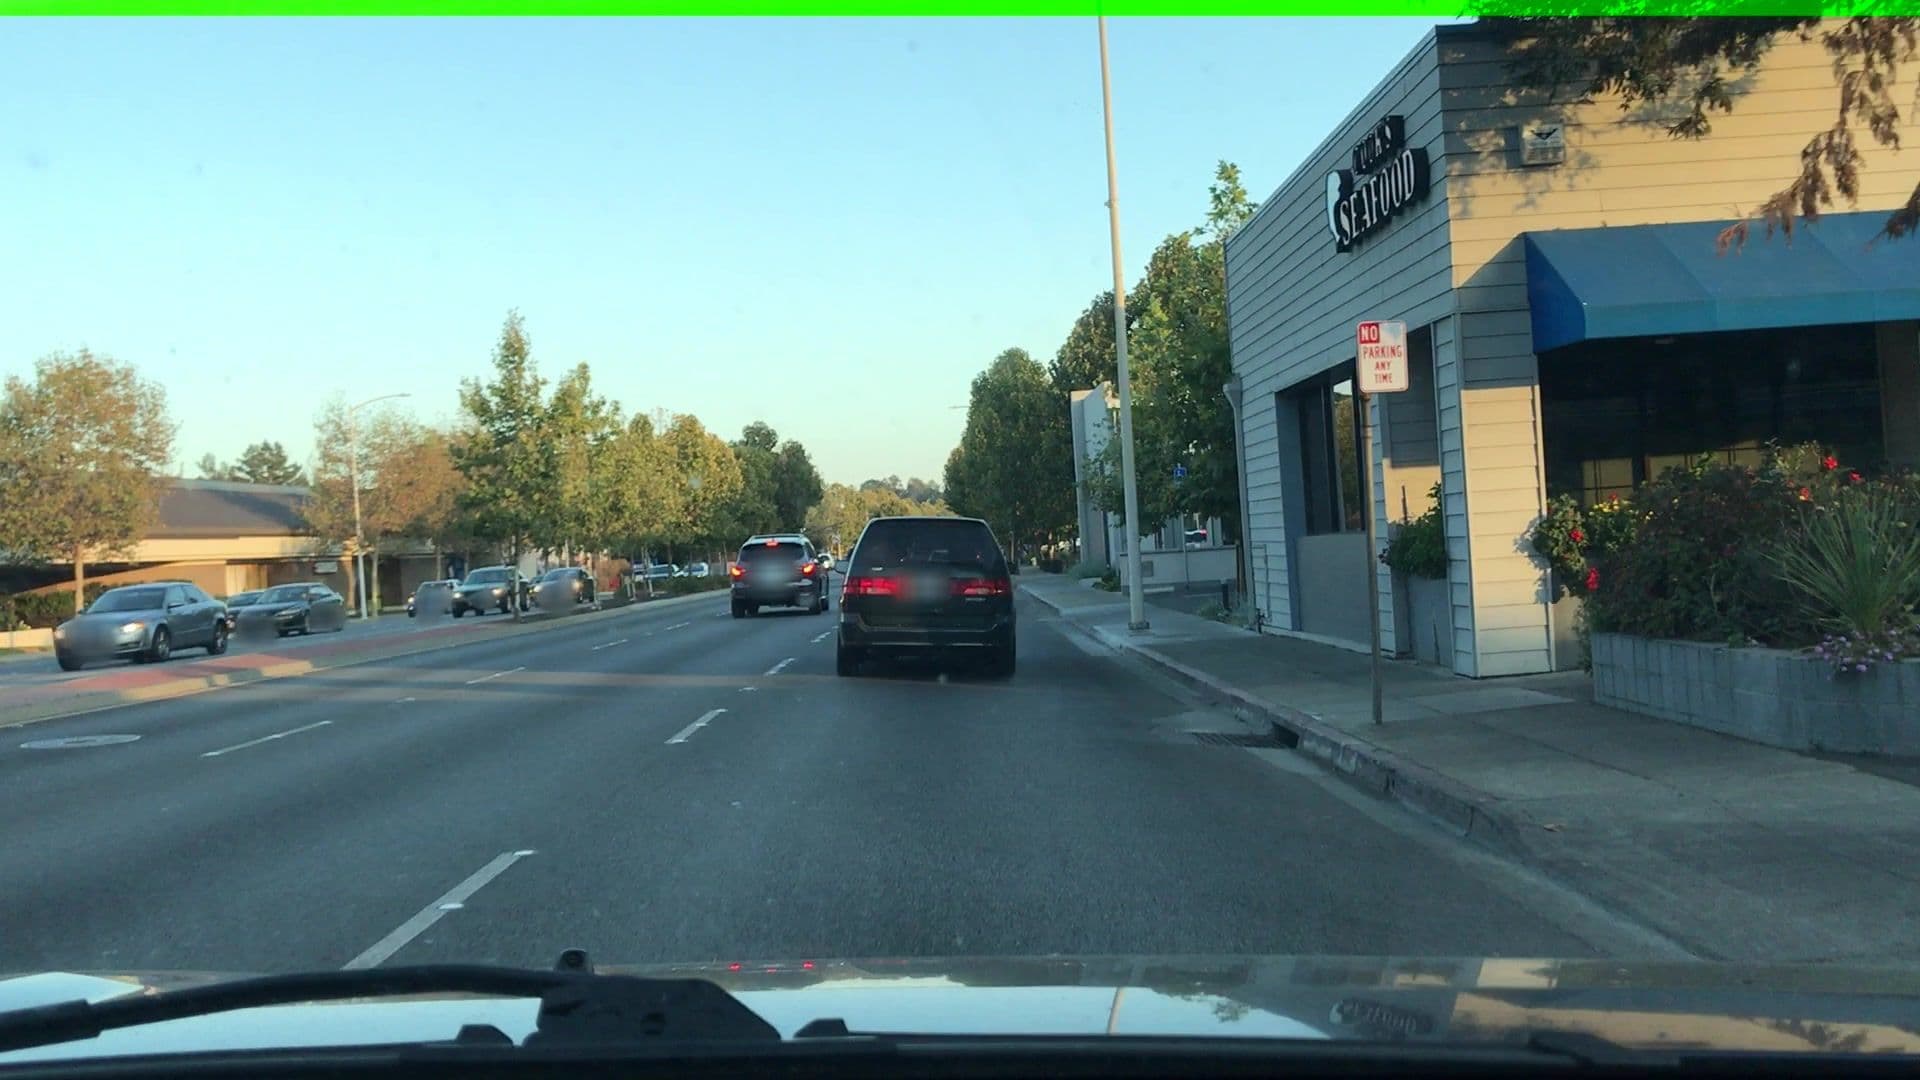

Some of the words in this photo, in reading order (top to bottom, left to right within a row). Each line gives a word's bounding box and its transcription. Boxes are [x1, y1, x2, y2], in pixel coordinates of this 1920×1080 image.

[1339, 149, 1416, 246] SEAFOOD
[1360, 325, 1378, 341] NO
[1363, 345, 1402, 359] PARKING
[1375, 361, 1391, 371] ANY
[1374, 373, 1393, 383] TIME
